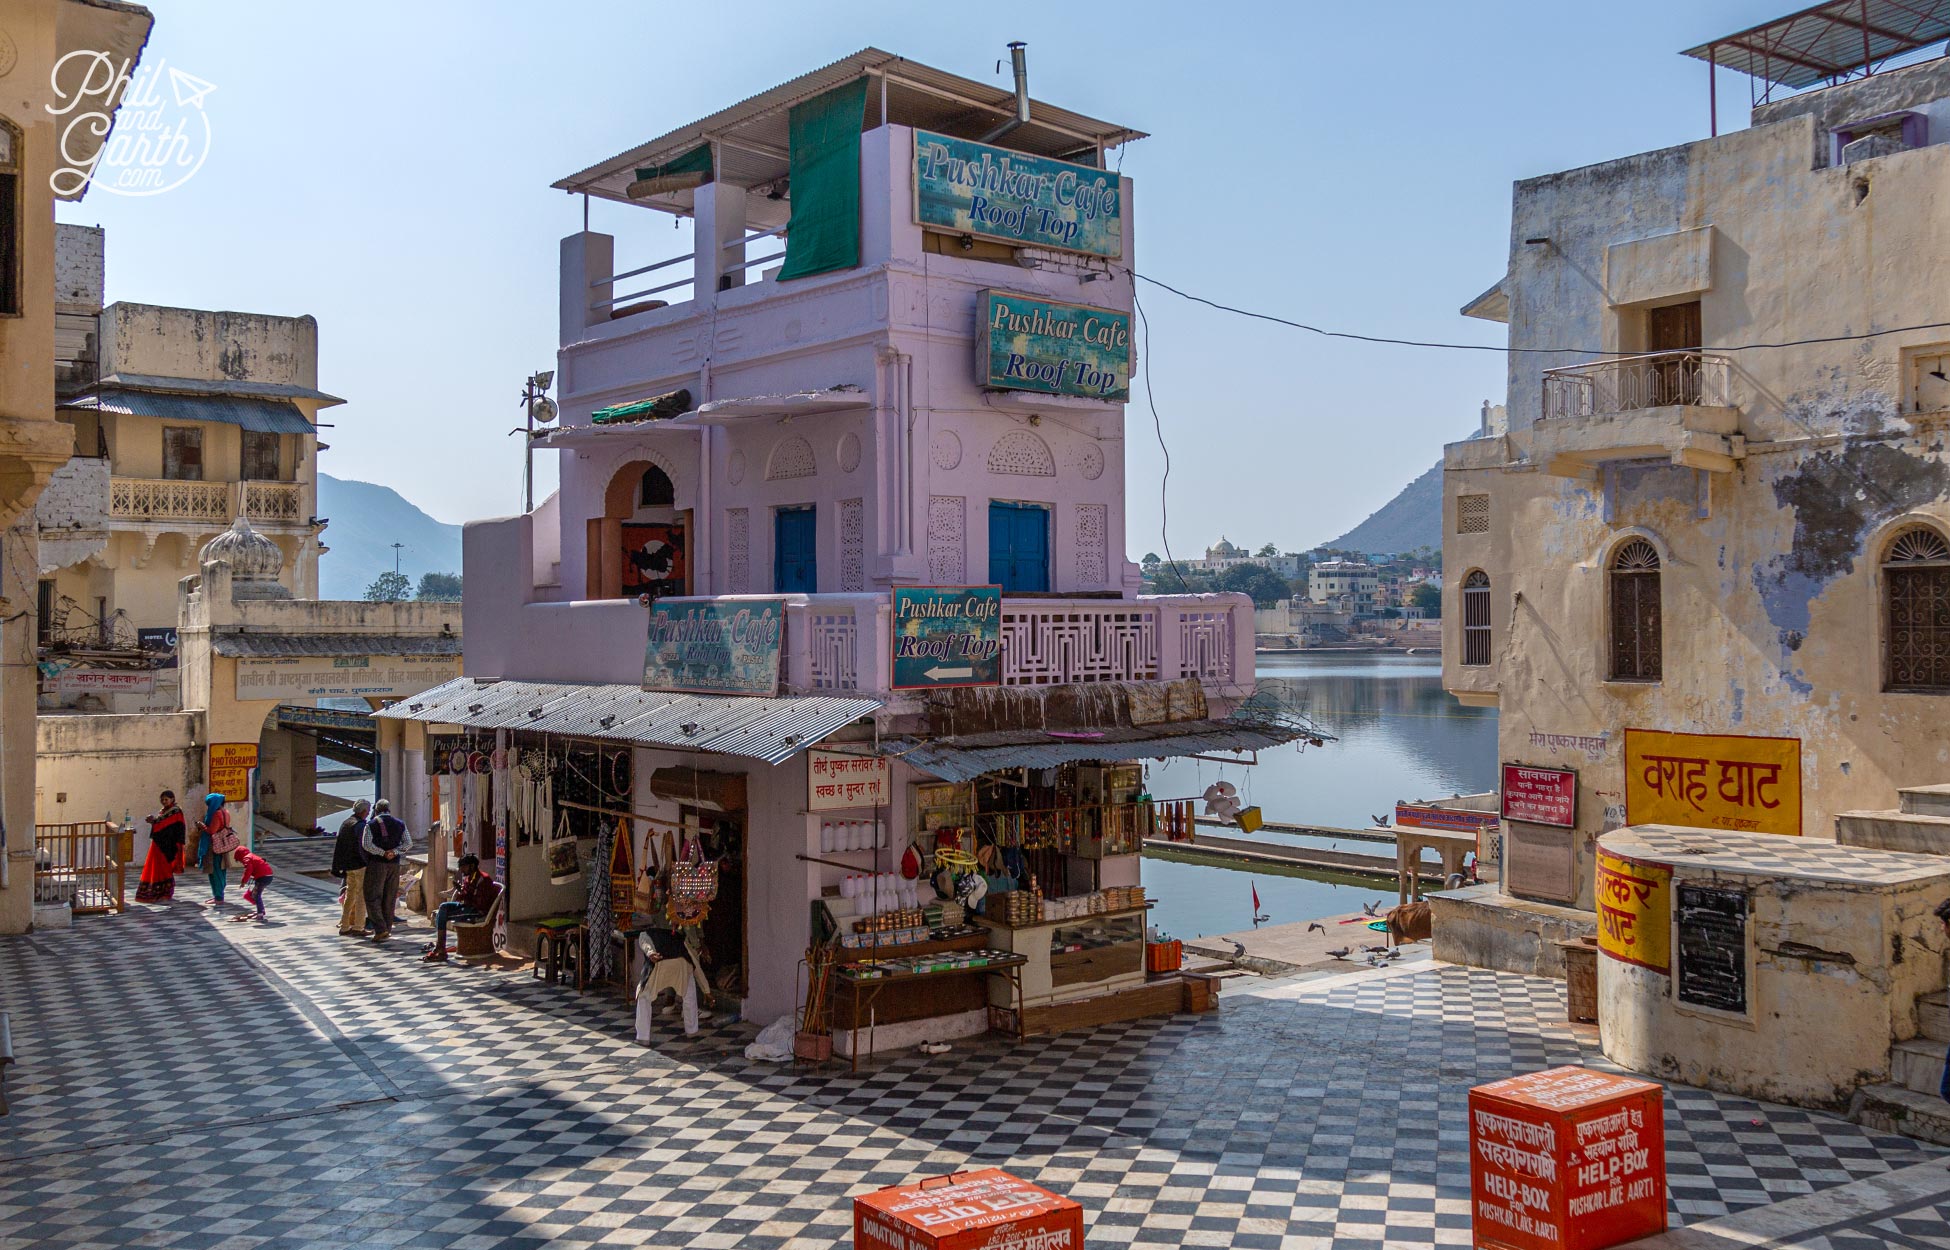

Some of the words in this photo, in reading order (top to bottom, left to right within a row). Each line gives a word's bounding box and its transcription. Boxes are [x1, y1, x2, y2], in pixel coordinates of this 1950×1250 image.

[924, 141, 1047, 202] Pushkar
[1054, 170, 1115, 220] Cafe
[969, 195, 1031, 235] Roof
[1036, 208, 1078, 243] Top
[992, 303, 1077, 340] Pushkar
[1083, 317, 1128, 352] Cafe
[1005, 353, 1070, 388] Roof
[1074, 362, 1116, 394] Top
[899, 596, 961, 620] Pushkar
[965, 596, 998, 624] Cafe
[651, 608, 729, 644] Pushkar
[731, 607, 777, 653] Cafe
[898, 633, 955, 662] Roof
[959, 634, 997, 661] Top
[686, 646, 711, 664] Roof
[713, 647, 731, 665] Top
[743, 654, 764, 665] PASTA
[224, 747, 237, 757] NO
[813, 756, 828, 775] तीर्थ
[830, 760, 850, 778] पुष्कर
[851, 755, 874, 772] सरोवर
[815, 784, 835, 799] स्वच्छ
[837, 784, 843, 797] व
[845, 782, 865, 801] सुन्दर
[1517, 769, 1561, 783] सावधान
[1641, 754, 1710, 812] वराह
[1716, 759, 1782, 809] घाट
[1601, 902, 1637, 945] घाट
[1584, 1136, 1616, 1161] सहयोग
[1578, 1148, 1649, 1187] HELP-BOX
[1484, 1171, 1551, 1213] HELP-BOX
[1510, 1200, 1527, 1216] FOR
[1569, 1190, 1603, 1218] PUSHKAR
[1604, 1186, 1624, 1209] LAKE
[1627, 1177, 1655, 1201] AARTI
[868, 1217, 909, 1250] DONATION
[1479, 1199, 1515, 1229] PUSHKAR
[1515, 1212, 1535, 1234] LAKE
[1535, 1219, 1559, 1241] AARTI
